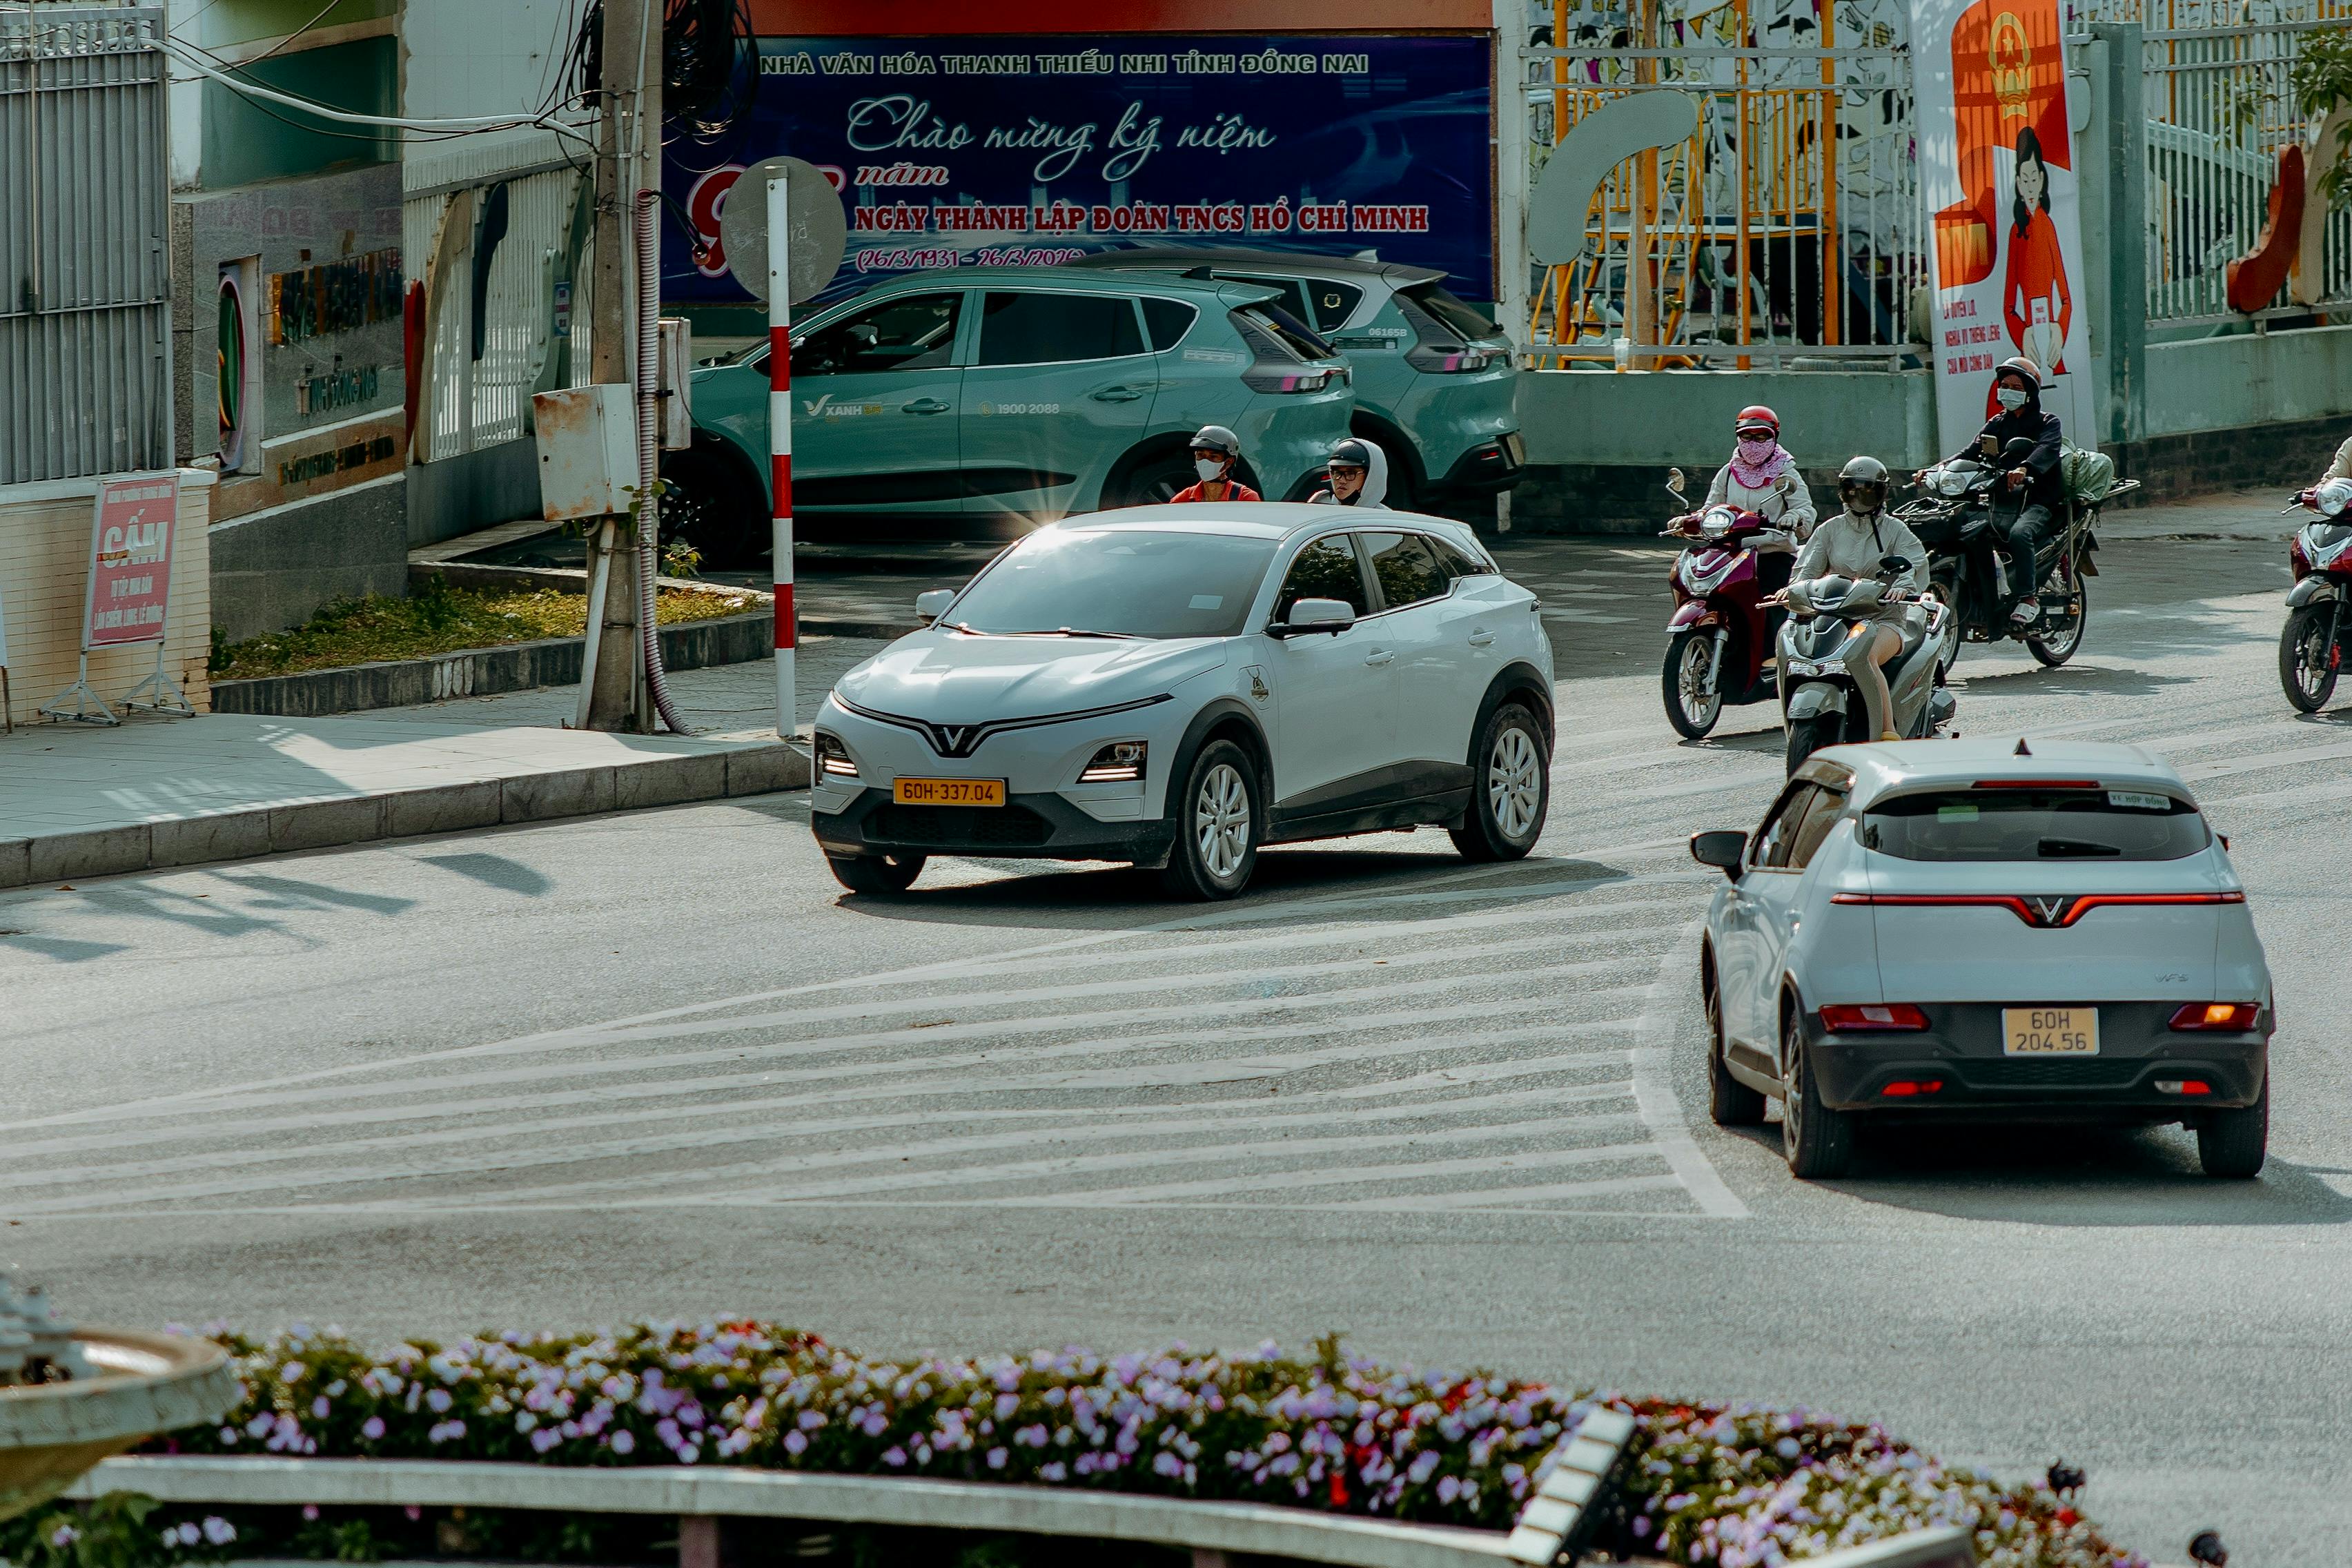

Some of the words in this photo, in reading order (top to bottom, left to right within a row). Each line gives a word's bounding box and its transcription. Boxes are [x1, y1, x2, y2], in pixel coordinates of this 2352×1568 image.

[760, 52, 816, 74] NHÀ
[819, 52, 874, 74] VĂN
[880, 52, 937, 74] HÓA
[940, 55, 1030, 74] THANH
[1035, 49, 1114, 74] THIẾU
[1120, 55, 1167, 74] NHI
[1173, 50, 1235, 74] TỈNH
[1239, 48, 1317, 74] ĐỒNG
[1322, 55, 1369, 74] NAI
[847, 94, 977, 151] Chào
[984, 116, 1098, 182] mừng
[1102, 100, 1163, 182] kỷ
[1177, 113, 1277, 155] niệm
[854, 162, 949, 186] năm
[854, 200, 928, 232] NGÀY
[934, 200, 1028, 232] THÀNH
[1033, 201, 1087, 237] LẬP
[1092, 200, 1170, 232] ĐOÀN
[1175, 205, 1244, 232] TNCS
[1251, 196, 1292, 232] HỒ
[1298, 200, 1348, 232] CHÍ
[1353, 205, 1429, 232] MINH
[856, 249, 959, 273] (26/3/1931
[825, 406, 862, 415] XANH
[998, 404, 1026, 414] 1900
[1029, 404, 1059, 414] 2088
[903, 783, 994, 801] 60H-337.04
[2031, 1012, 2070, 1029] 60H
[2016, 1033, 2087, 1051] 204.56
